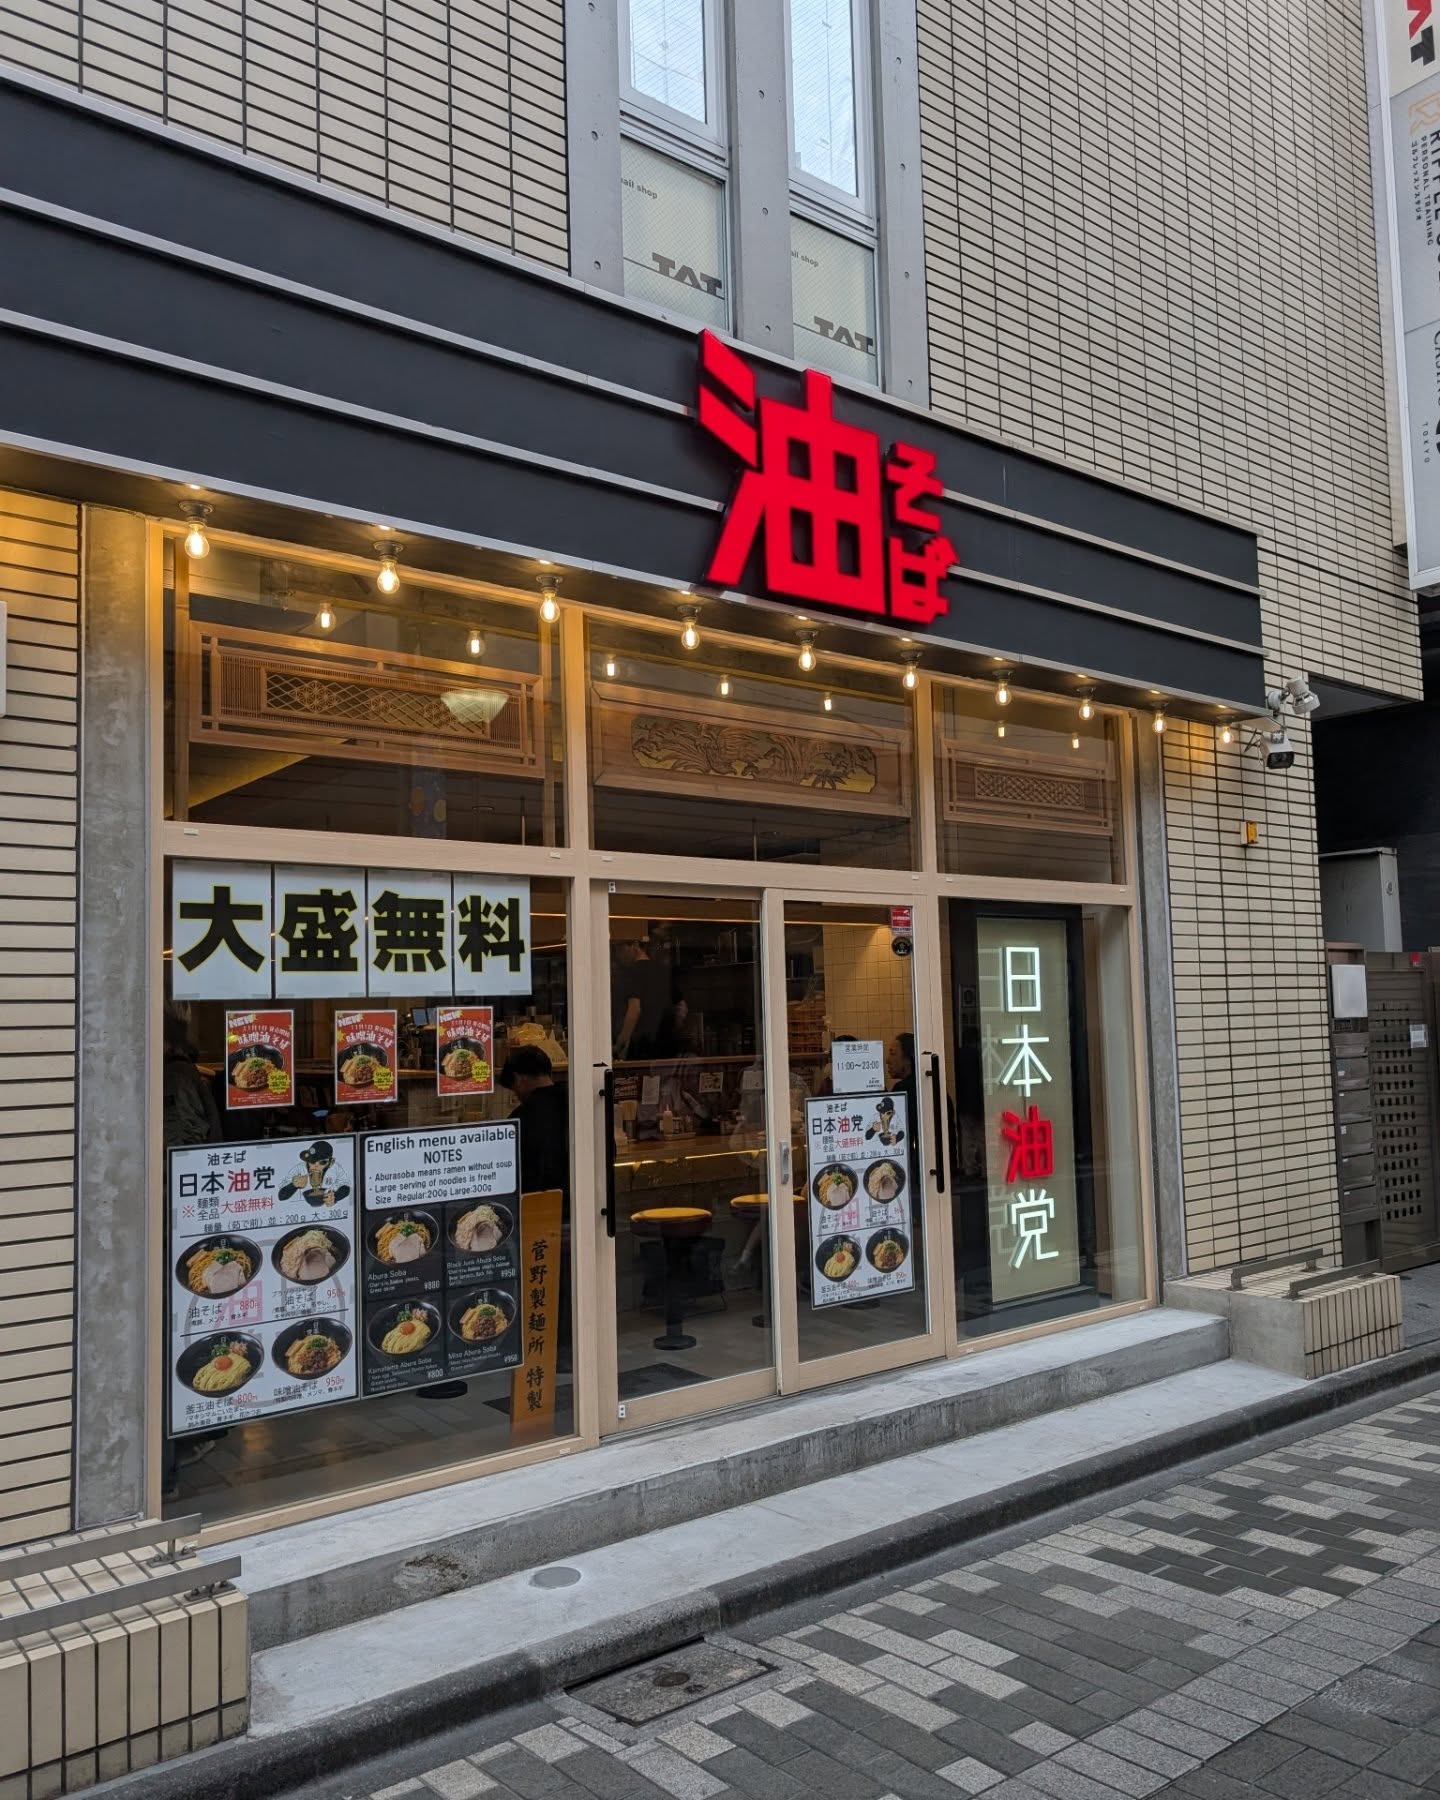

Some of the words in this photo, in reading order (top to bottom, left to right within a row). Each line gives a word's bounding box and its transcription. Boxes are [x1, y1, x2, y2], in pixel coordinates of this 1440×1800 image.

[1421, 135, 1430, 191] PERSONAL
[636, 185, 658, 200] shop
[1424, 194, 1434, 246] TRAINING
[651, 251, 723, 297] TAT
[813, 315, 874, 353] TAT
[1422, 421, 1431, 463] TOKYO
[177, 884, 527, 973] 大盛無料
[228, 1014, 254, 1028] NEW
[338, 1014, 361, 1027] NEW
[440, 1011, 460, 1022] NEW
[826, 1102, 848, 1113] 油そば
[1001, 945, 1060, 1269] 日本油党
[812, 1114, 864, 1135] 日本油党
[366, 1135, 415, 1154] English
[418, 1132, 456, 1148] menu
[460, 1127, 516, 1144] available
[207, 1150, 247, 1167] 油そば
[423, 1148, 463, 1165] NOTES
[375, 1169, 415, 1182] Aburasoba
[417, 1168, 442, 1177] means
[444, 1164, 466, 1174] ramen
[468, 1161, 494, 1172] without
[496, 1160, 513, 1170] soup
[179, 1166, 275, 1198] 日本油党
[375, 1183, 397, 1194] Large
[399, 1179, 426, 1192] serving
[428, 1176, 436, 1187] of
[438, 1175, 467, 1187] noodles
[469, 1174, 476, 1183] is
[375, 1195, 392, 1205] Size
[397, 1188, 448, 1203] Regular:200g
[450, 1183, 492, 1196] Large:300g
[221, 1195, 273, 1215] 大盛無料
[197, 1210, 220, 1222] 全品
[389, 1270, 407, 1278] Soba
[188, 1303, 222, 1319] 油そば
